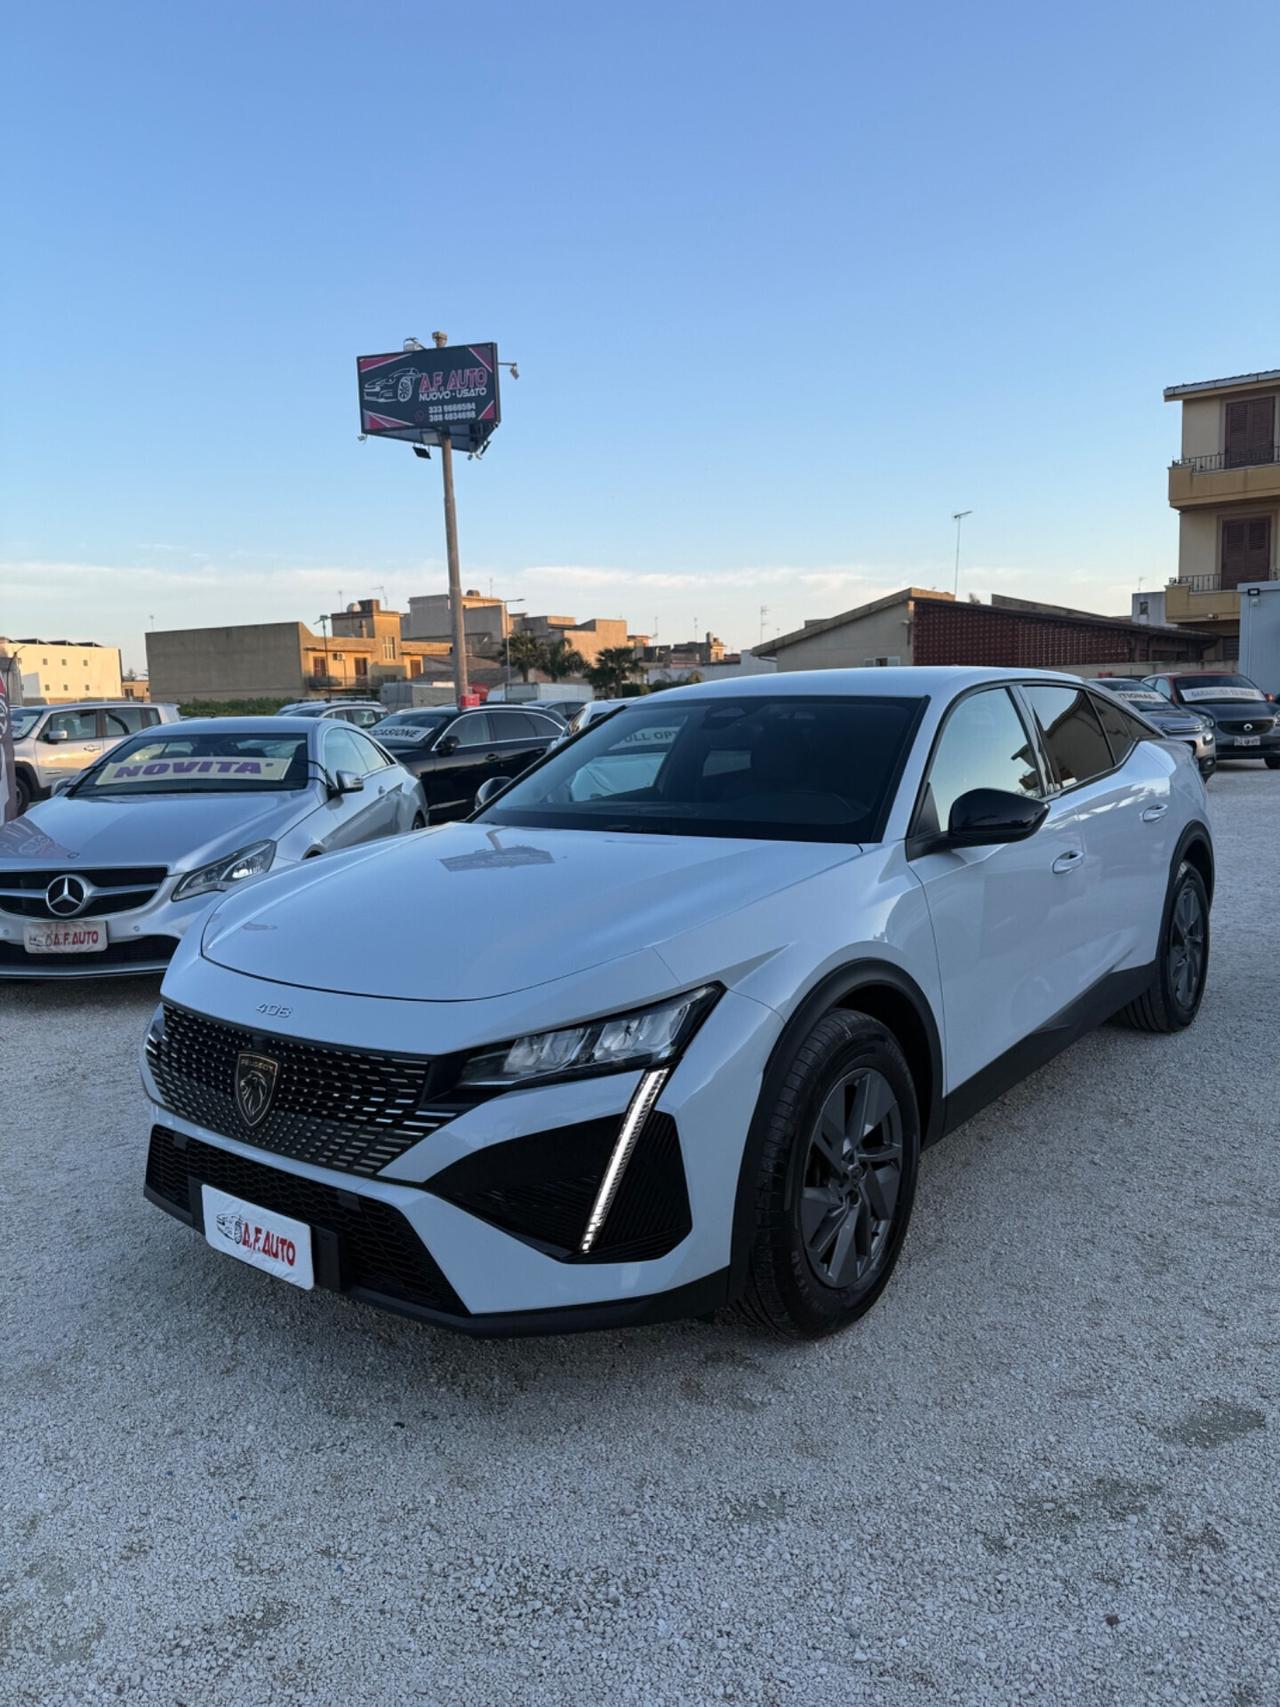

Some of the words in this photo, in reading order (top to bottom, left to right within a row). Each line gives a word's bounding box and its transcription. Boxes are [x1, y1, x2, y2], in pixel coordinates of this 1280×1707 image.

[447, 368, 487, 389] AUTO
[419, 391, 451, 401] NUOVO
[456, 388, 486, 398] USATO
